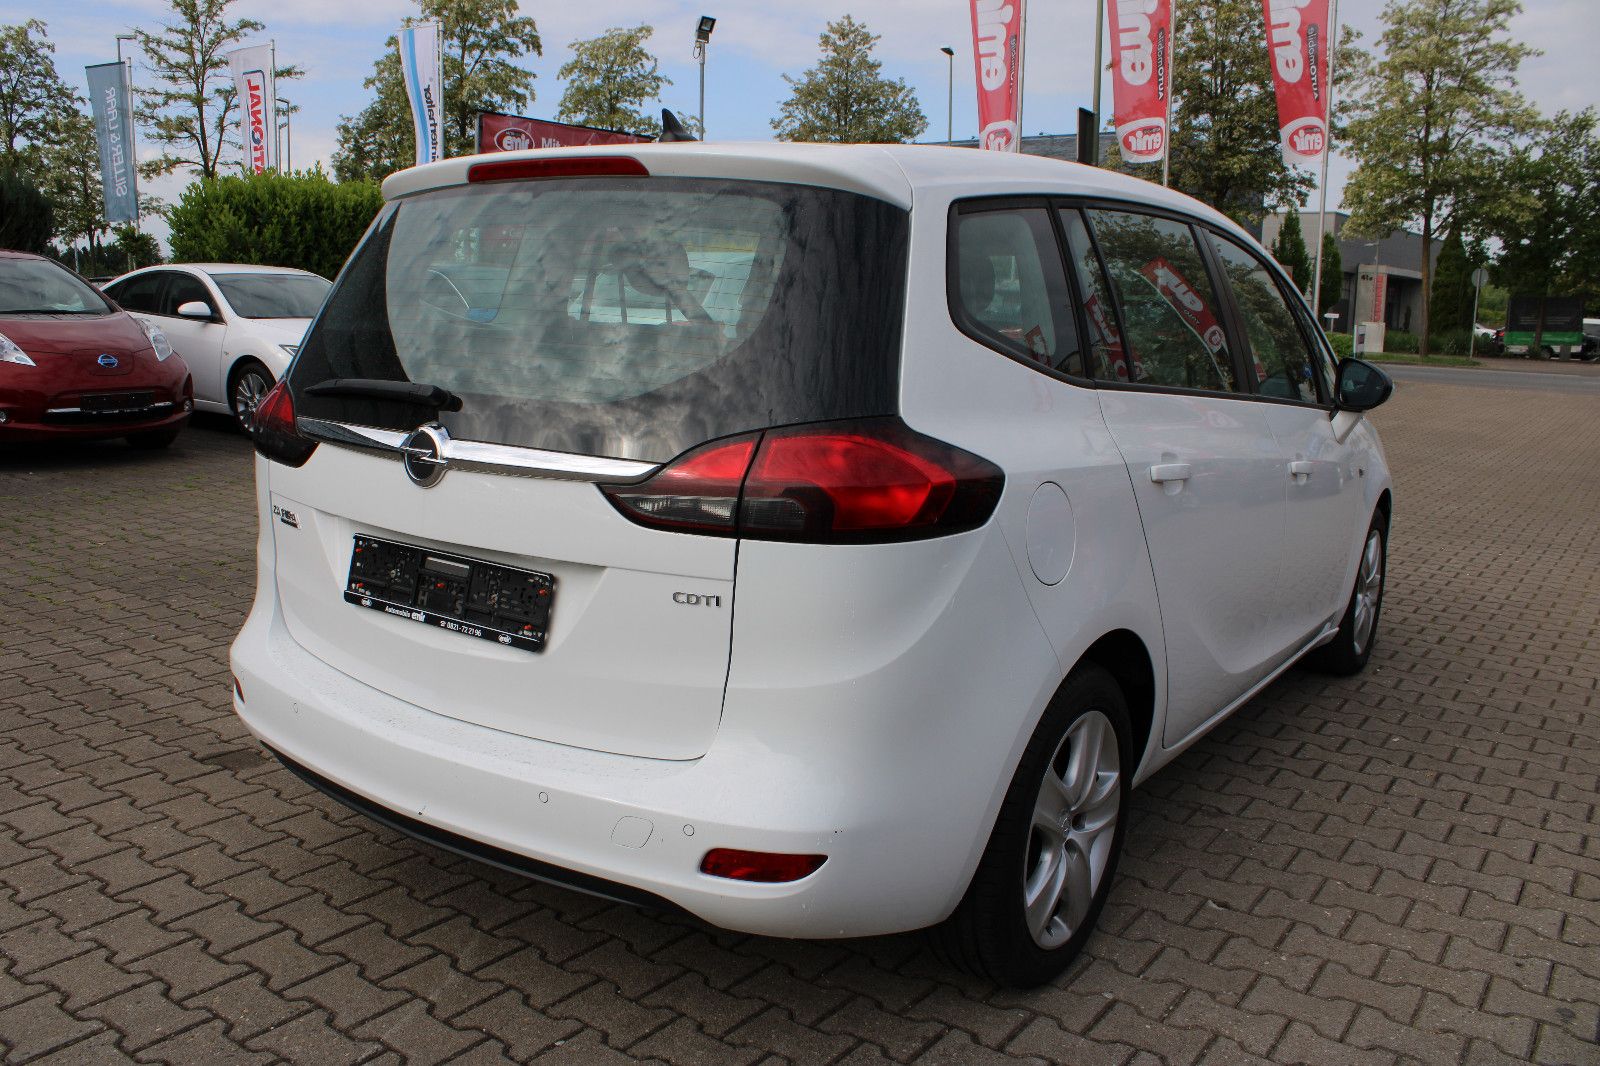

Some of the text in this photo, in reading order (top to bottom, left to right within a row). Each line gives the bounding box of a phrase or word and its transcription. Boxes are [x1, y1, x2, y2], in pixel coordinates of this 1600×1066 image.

[502, 133, 530, 150] emir
[672, 591, 720, 607] CDTI
[411, 611, 426, 622] emir
